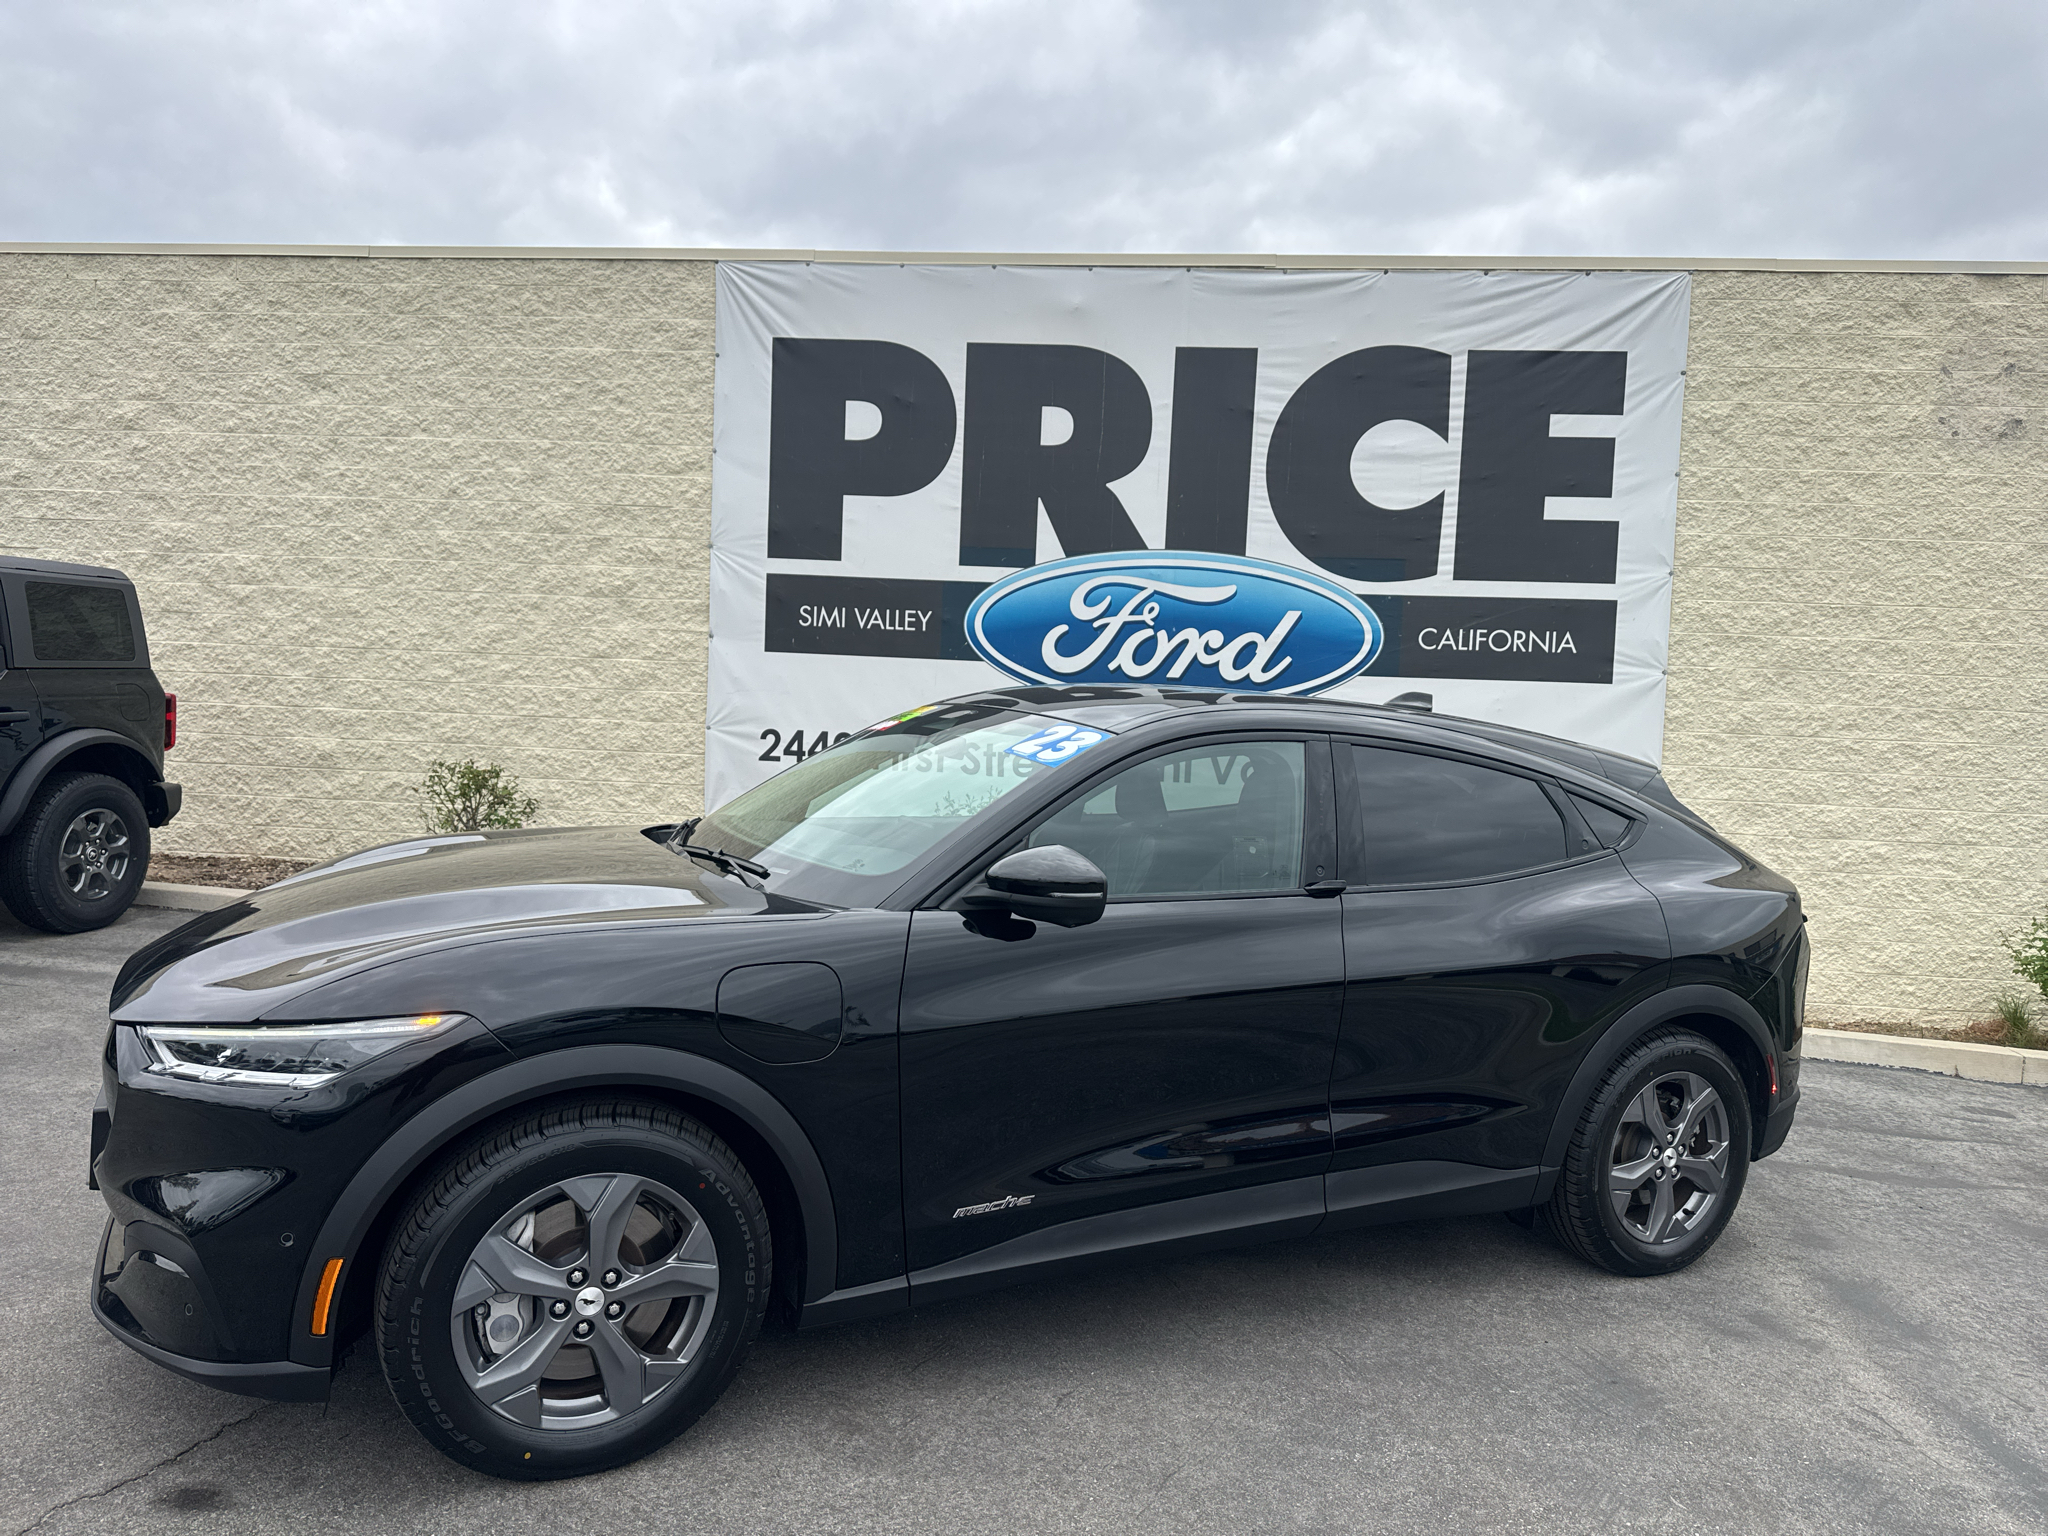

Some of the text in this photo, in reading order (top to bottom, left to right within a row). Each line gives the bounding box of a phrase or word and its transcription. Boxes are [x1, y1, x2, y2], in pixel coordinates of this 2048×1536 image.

[767, 336, 1628, 584] PRICE
[798, 604, 933, 632] SIMI VALLEY
[1041, 575, 1303, 684] Ford
[1417, 627, 1578, 654] CALIFORNIA
[1010, 725, 1103, 763] 23
[698, 1167, 756, 1303] Advantage
[406, 1296, 487, 1454] BFGoodrich
